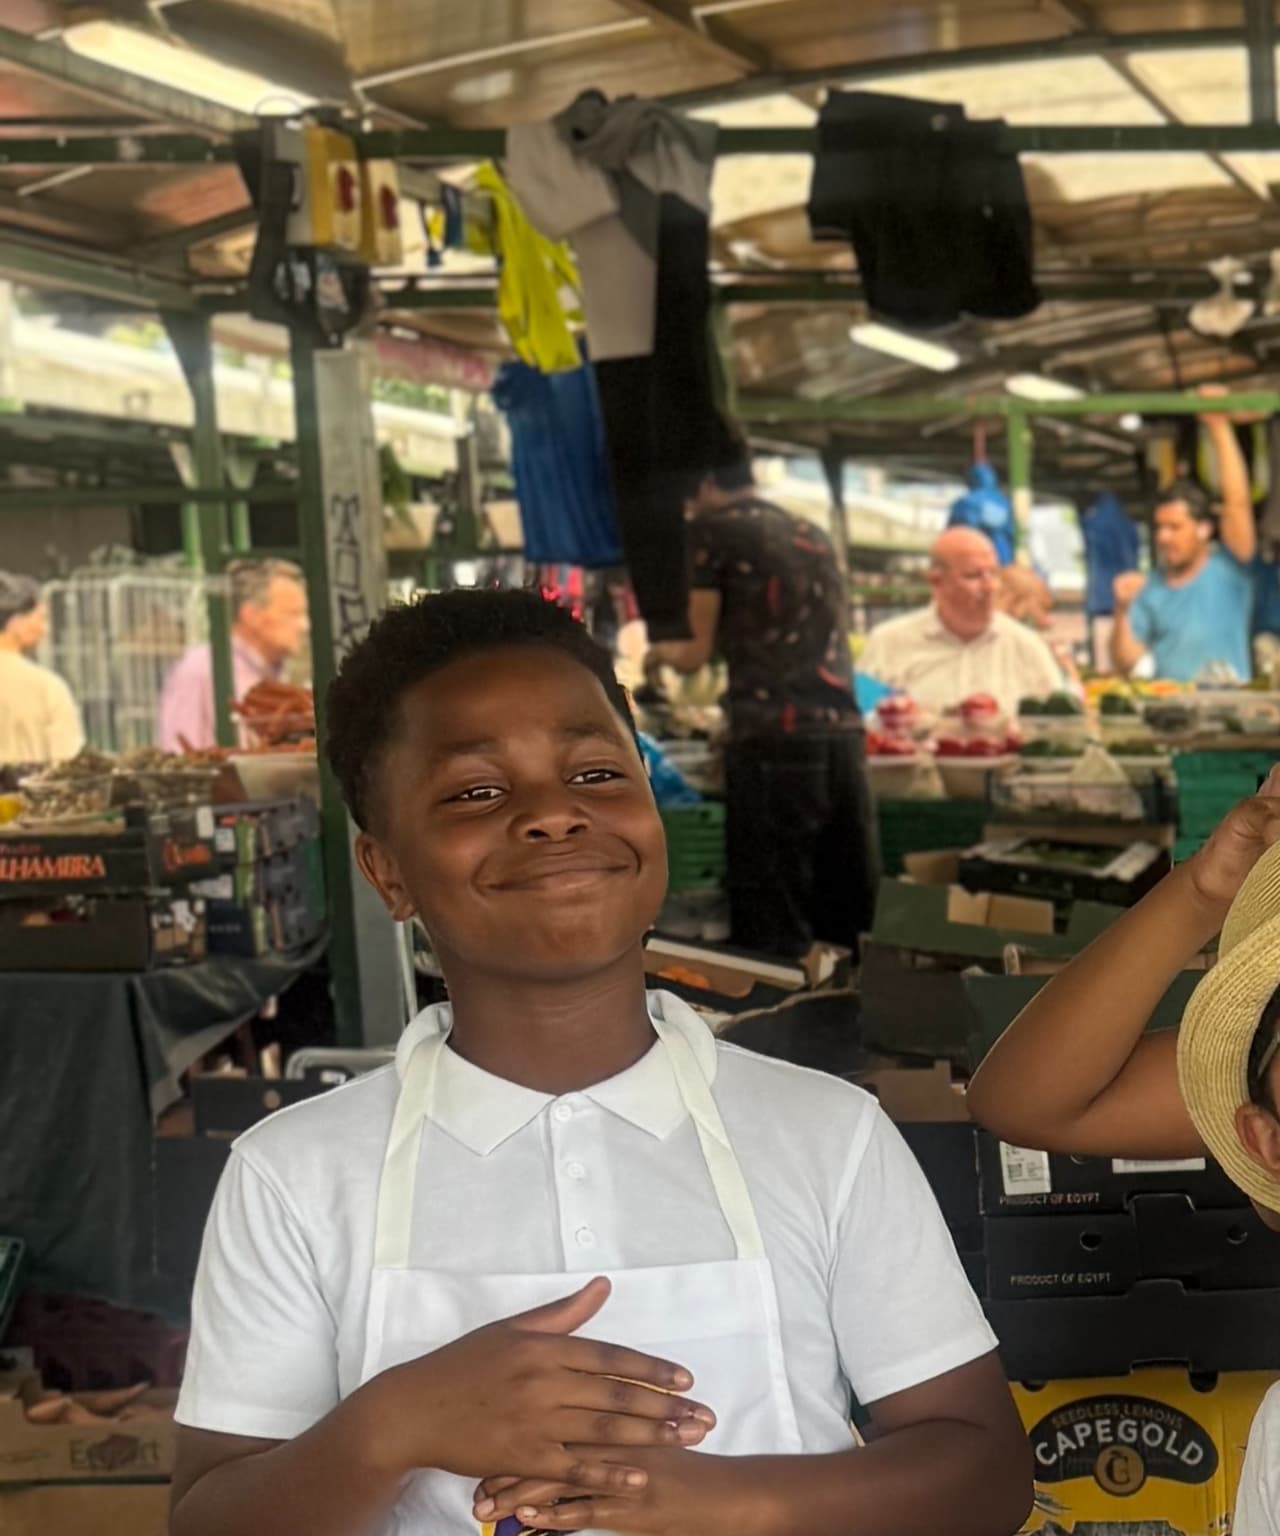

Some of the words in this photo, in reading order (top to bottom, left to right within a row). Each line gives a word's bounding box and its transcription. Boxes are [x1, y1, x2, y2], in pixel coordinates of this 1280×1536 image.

[1051, 1193, 1065, 1204] OF
[1067, 1192, 1100, 1204] EGYPT
[1010, 1274, 1058, 1285] PRODUCT
[1062, 1273, 1074, 1284] OF
[1077, 1272, 1111, 1283] EGYPT
[1052, 1402, 1119, 1428] SEEDLESS
[1124, 1402, 1184, 1429] LEMONS
[1034, 1417, 1204, 1467] CAPEGOLD
